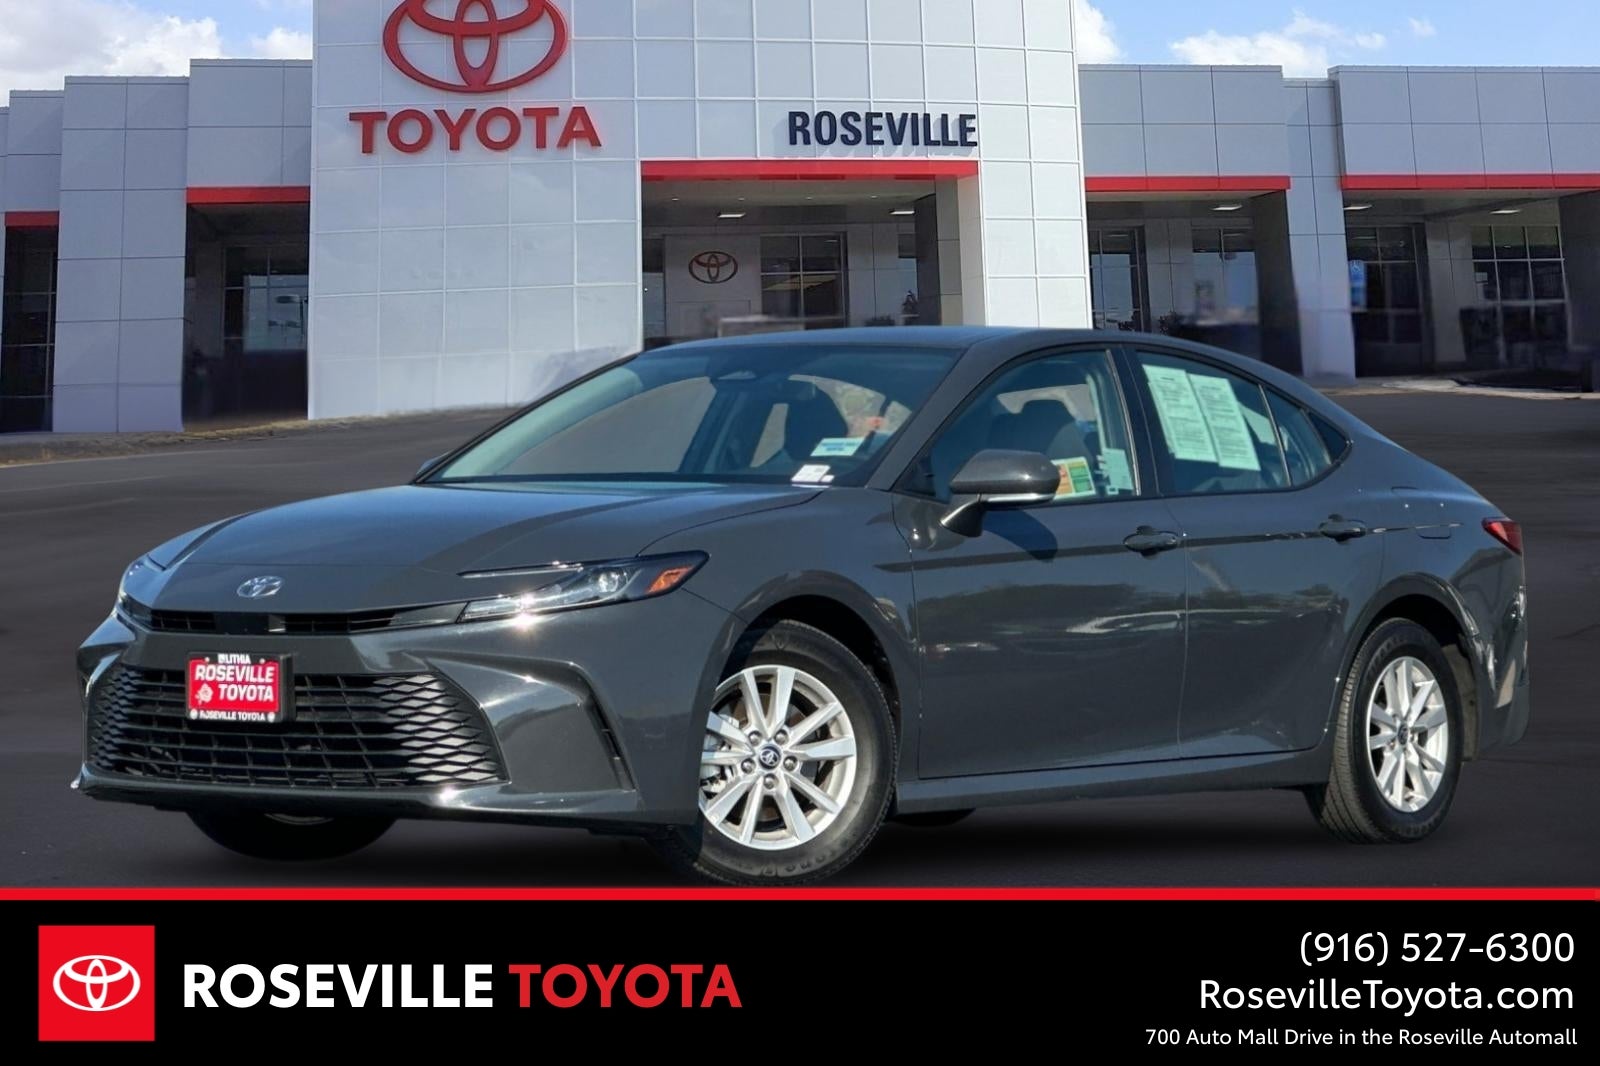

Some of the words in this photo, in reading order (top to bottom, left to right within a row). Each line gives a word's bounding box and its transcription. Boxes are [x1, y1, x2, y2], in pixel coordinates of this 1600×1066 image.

[349, 106, 602, 154] TOYOTA
[788, 111, 978, 147] ROSEVILLE
[195, 665, 275, 683] ROSEVILLE
[218, 684, 274, 702] TOYOTA
[199, 710, 237, 720] ROSEVILLE
[238, 711, 265, 721] TOYOTA
